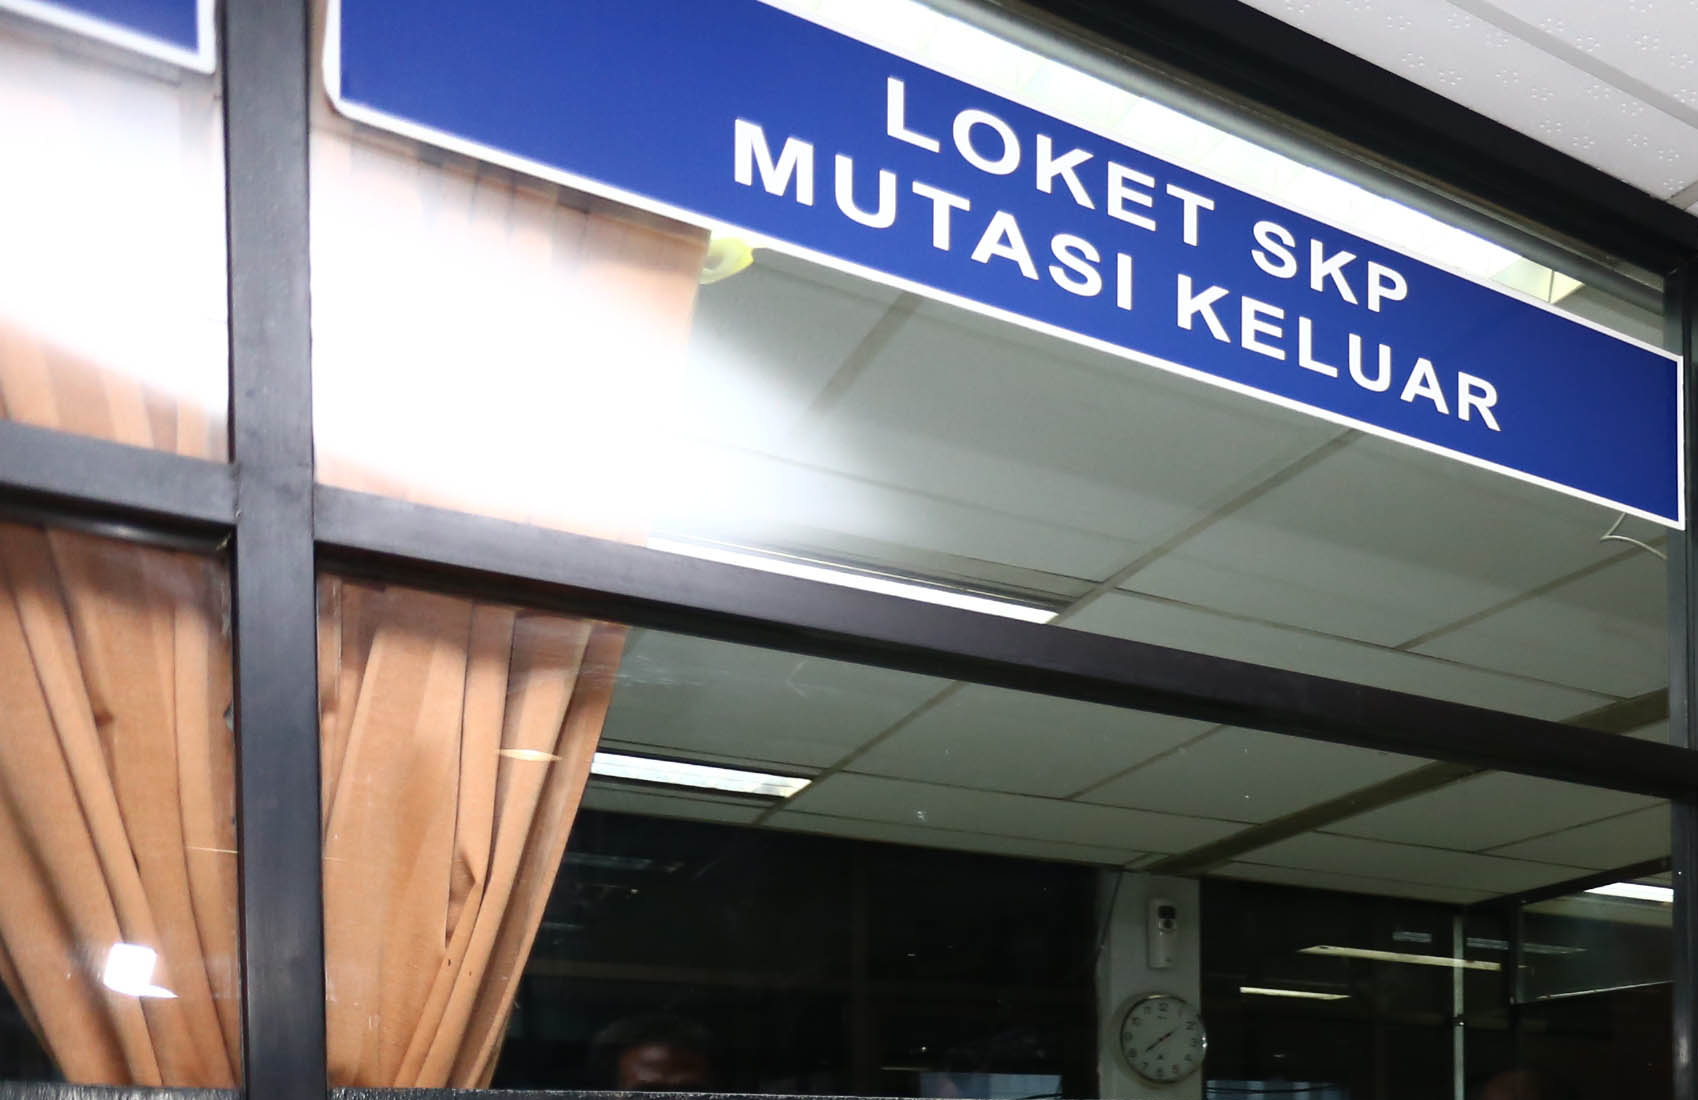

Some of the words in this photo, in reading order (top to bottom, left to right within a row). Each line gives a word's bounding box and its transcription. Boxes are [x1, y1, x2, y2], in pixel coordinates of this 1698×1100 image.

[733, 118, 1133, 310] MUTASI
[1176, 275, 1502, 432] KELUAR
[886, 77, 1214, 247] LOKET
[1250, 221, 1409, 313] SKP
